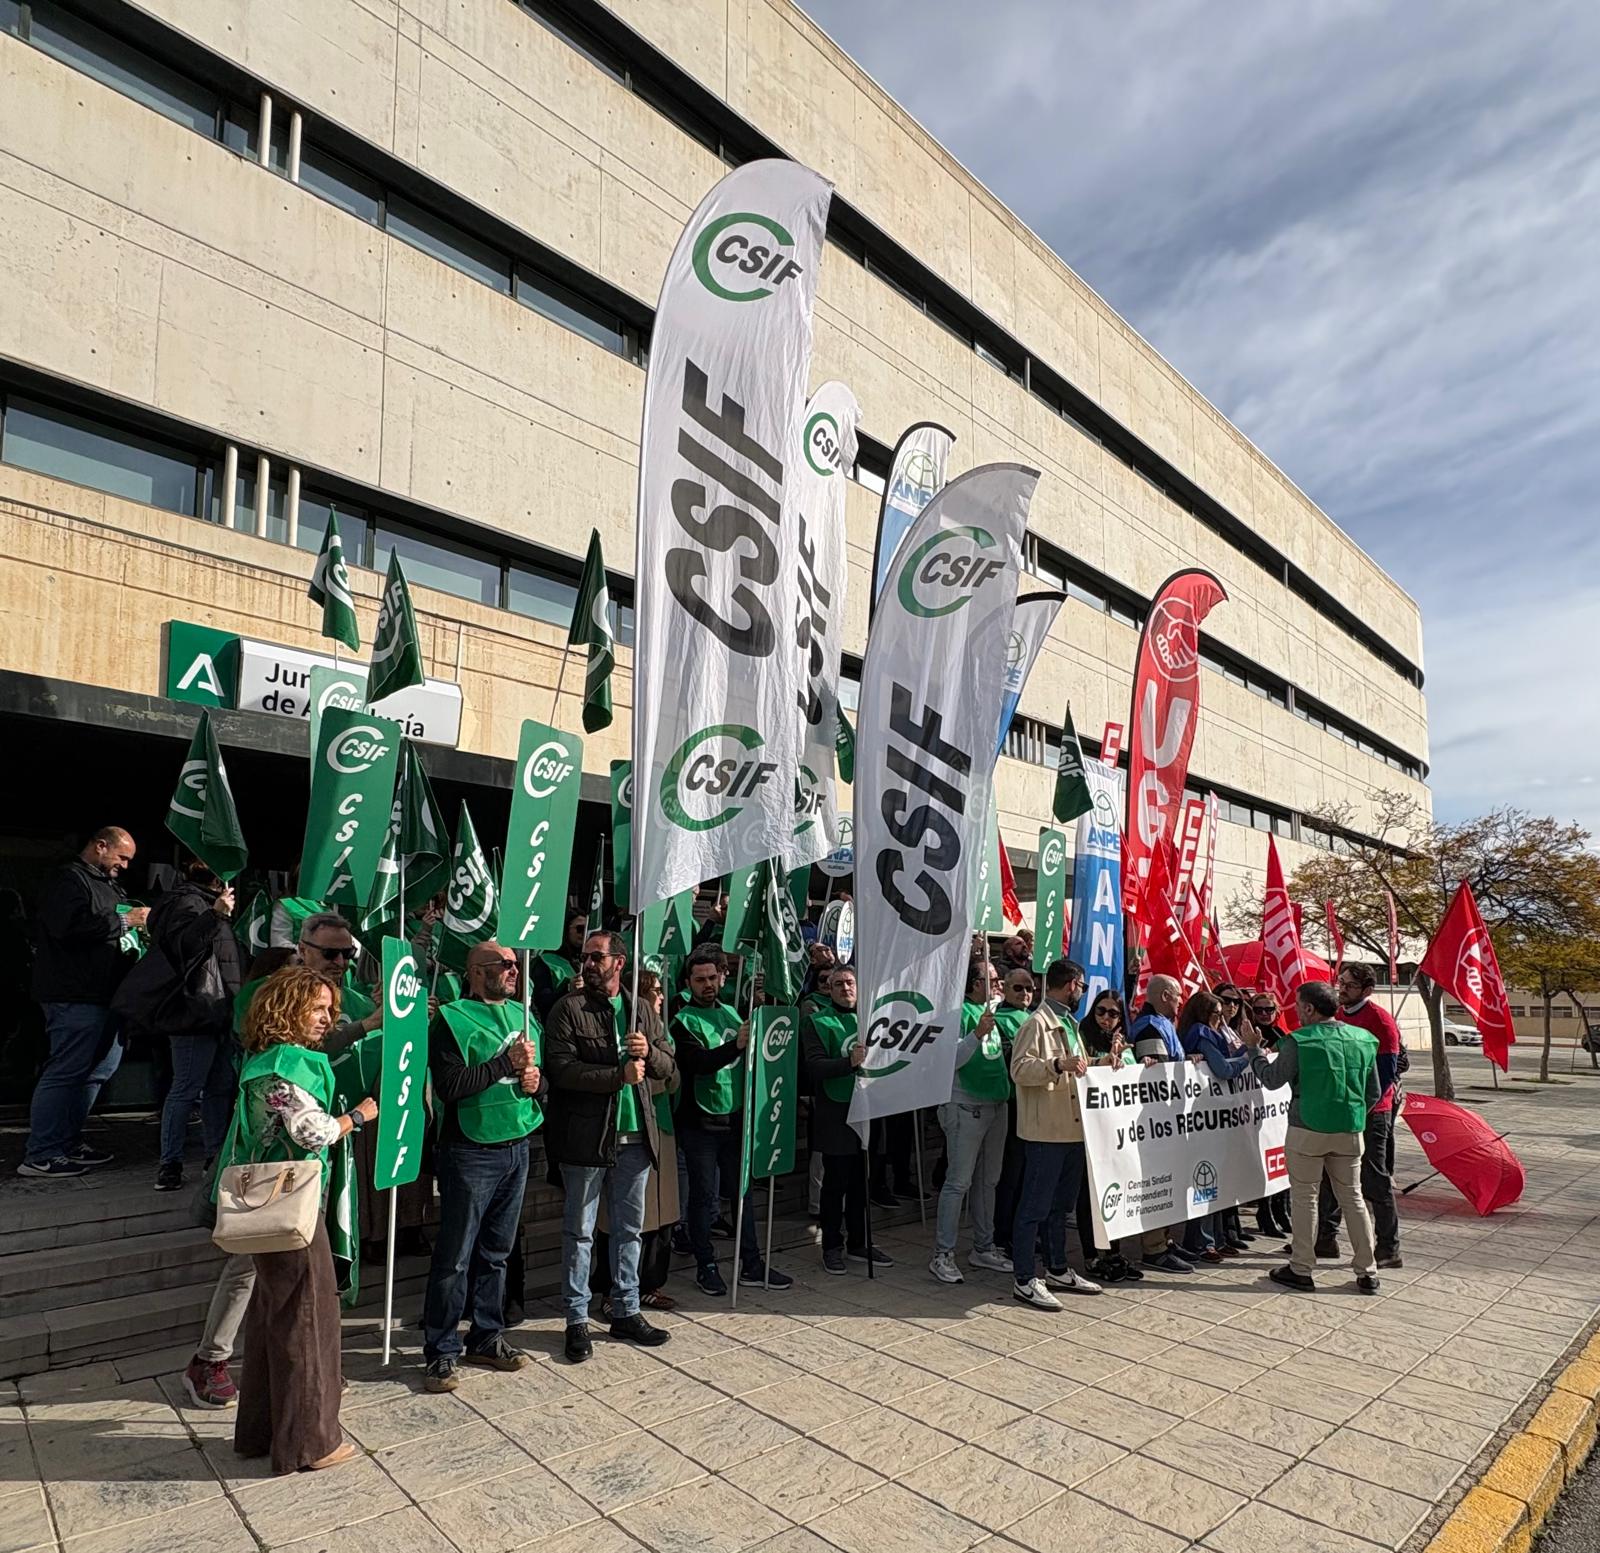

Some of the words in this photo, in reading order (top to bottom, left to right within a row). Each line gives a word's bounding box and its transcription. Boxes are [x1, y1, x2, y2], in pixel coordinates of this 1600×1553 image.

[716, 234, 804, 286] CSIF
[665, 356, 784, 658] CSIF
[891, 476, 933, 507] ANP
[920, 552, 1007, 588] CSIF
[262, 690, 296, 714] de
[340, 738, 390, 762] CSIF
[533, 756, 574, 783] CSIF
[686, 754, 778, 798] CSIF
[796, 787, 827, 815] SIF
[876, 681, 971, 935] CSIF
[327, 793, 363, 896] CSIF
[1087, 827, 1120, 851] ANPE
[1046, 849, 1064, 866] CSIF
[447, 847, 495, 911] CSIF
[519, 821, 550, 941] CSIF
[979, 860, 991, 925] SIF
[1042, 890, 1056, 969] CSIF
[1088, 868, 1116, 1004] ANP
[396, 973, 421, 998] CSIF
[768, 1029, 794, 1047] CSIF
[866, 1017, 944, 1054] CSIF
[1086, 1086, 1109, 1109] En
[1113, 1079, 1181, 1107] DEFENSA
[1185, 1078, 1200, 1099] de
[1208, 1076, 1222, 1097] la
[1227, 1071, 1264, 1095] MOVIL
[391, 1041, 412, 1179] CSIF
[767, 1076, 783, 1171] CSIF
[1116, 1125, 1125, 1150] y
[1129, 1120, 1145, 1141] de
[1150, 1118, 1172, 1139] los
[1176, 1104, 1250, 1135] RECURSOS
[1253, 1103, 1277, 1126] para
[1279, 1100, 1290, 1115] co
[1267, 1153, 1285, 1172] CC
[1126, 1189, 1168, 1204] Independiente
[1127, 1179, 1151, 1189] Central
[1151, 1173, 1173, 1186] Sindical
[1192, 1186, 1218, 1203] ANPE
[1105, 1193, 1123, 1209] CSIF
[1126, 1207, 1135, 1218] de
